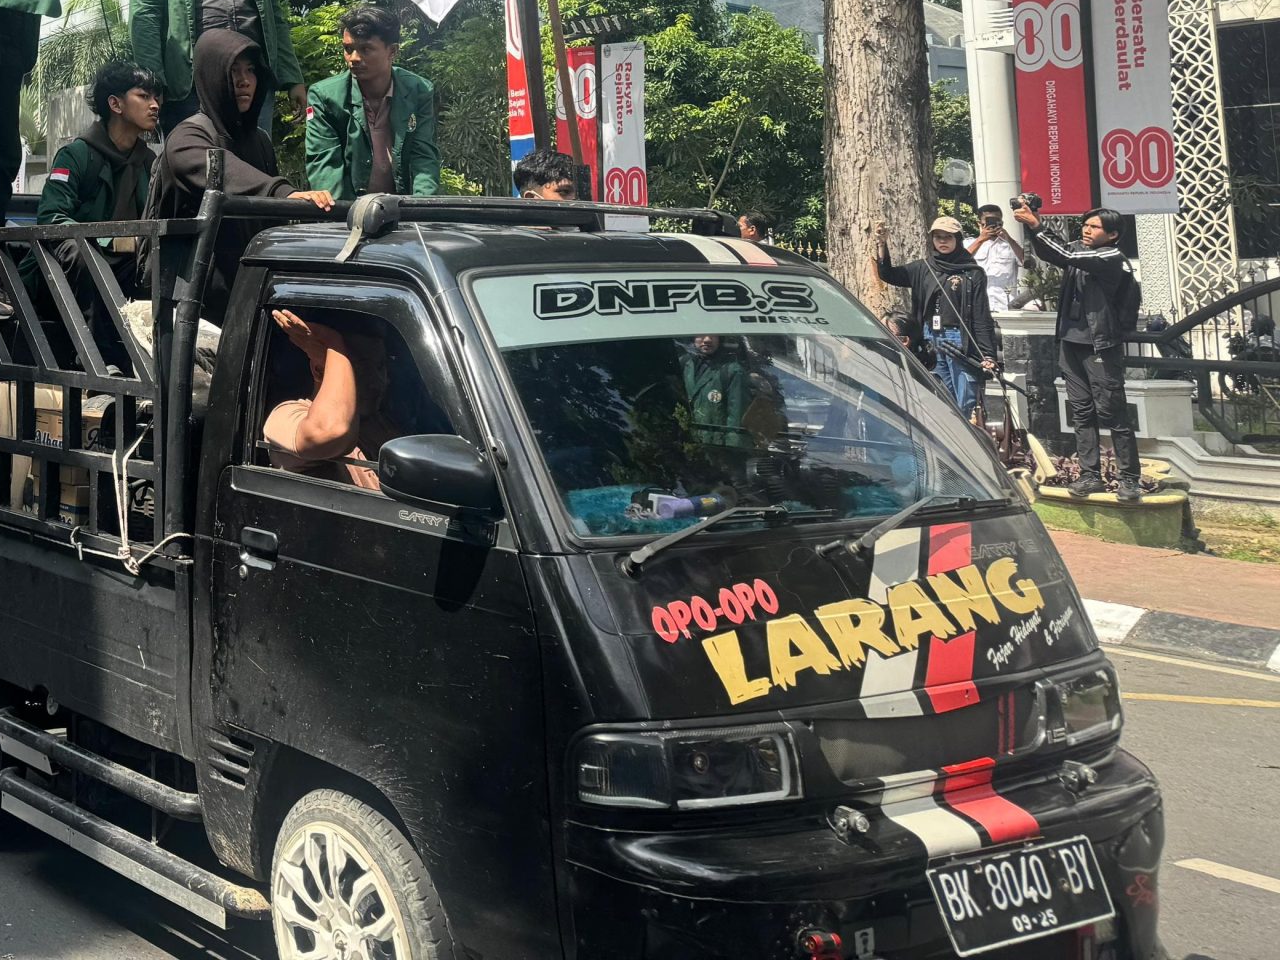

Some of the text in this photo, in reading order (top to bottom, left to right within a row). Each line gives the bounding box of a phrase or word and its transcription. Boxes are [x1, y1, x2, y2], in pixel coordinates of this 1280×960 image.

[624, 62, 633, 115] Rakyat
[1045, 80, 1062, 205] DIRGAHAYU REPUBLIK INDONESIA
[1101, 126, 1175, 189] 80
[605, 166, 648, 207] 80
[651, 578, 780, 644] OPO-OPO
[701, 557, 1045, 705] LARANG
[1043, 628, 1054, 646] &
[938, 869, 983, 921] BK
[984, 854, 1052, 911] 8040
[1058, 844, 1094, 895] BY
